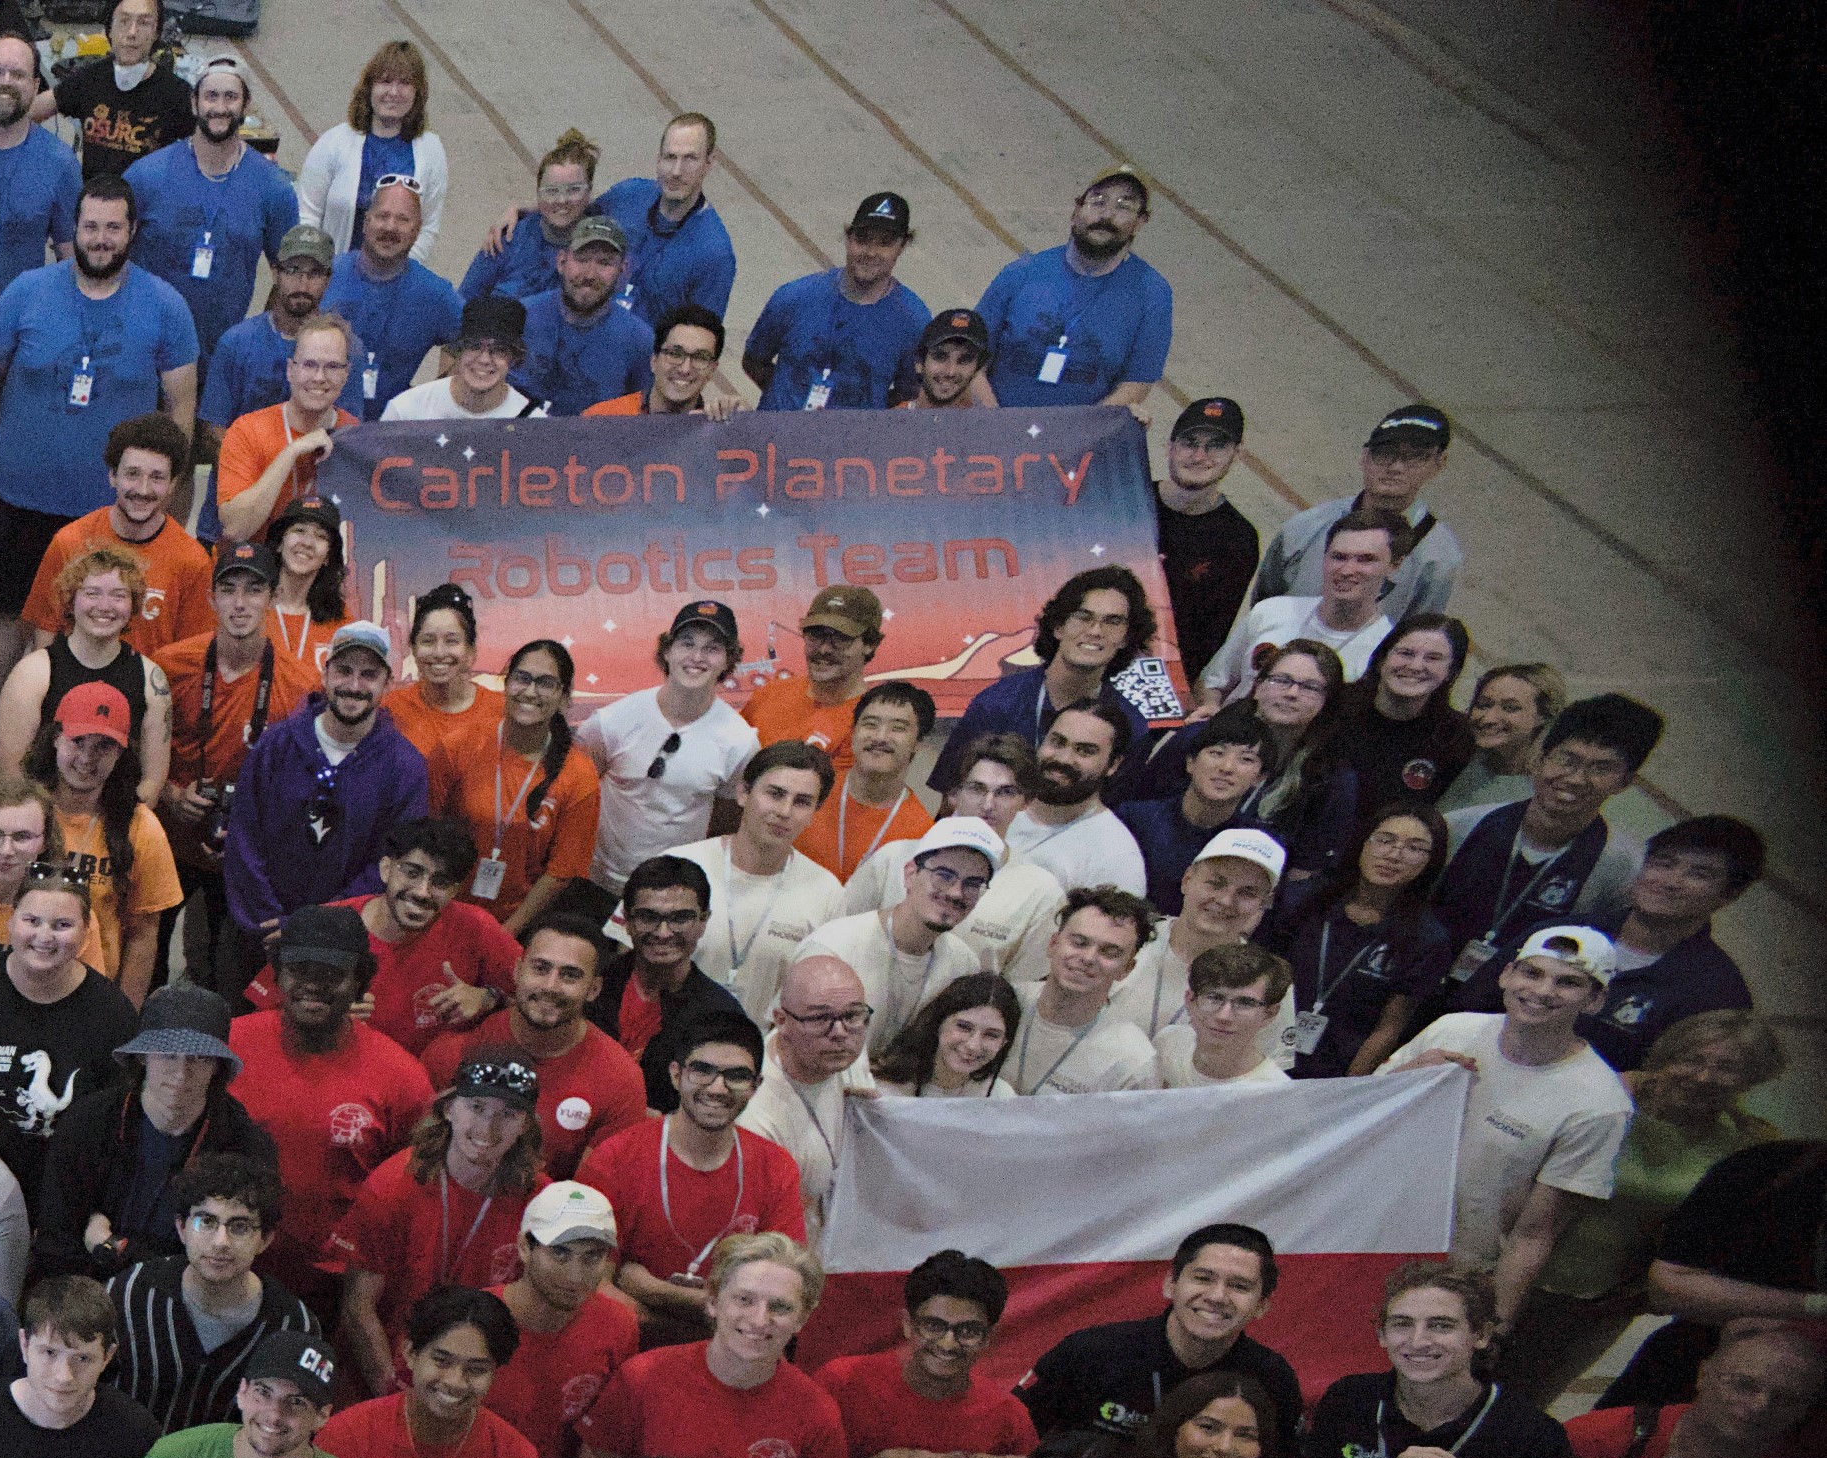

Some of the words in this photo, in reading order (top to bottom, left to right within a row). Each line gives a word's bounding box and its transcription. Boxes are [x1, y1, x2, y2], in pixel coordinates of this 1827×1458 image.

[371, 450, 685, 509] Carleton
[715, 444, 1094, 505] Planetary
[448, 529, 776, 600] Robotics
[797, 533, 1020, 588] Team
[1484, 1115, 1530, 1142] PHOENIX
